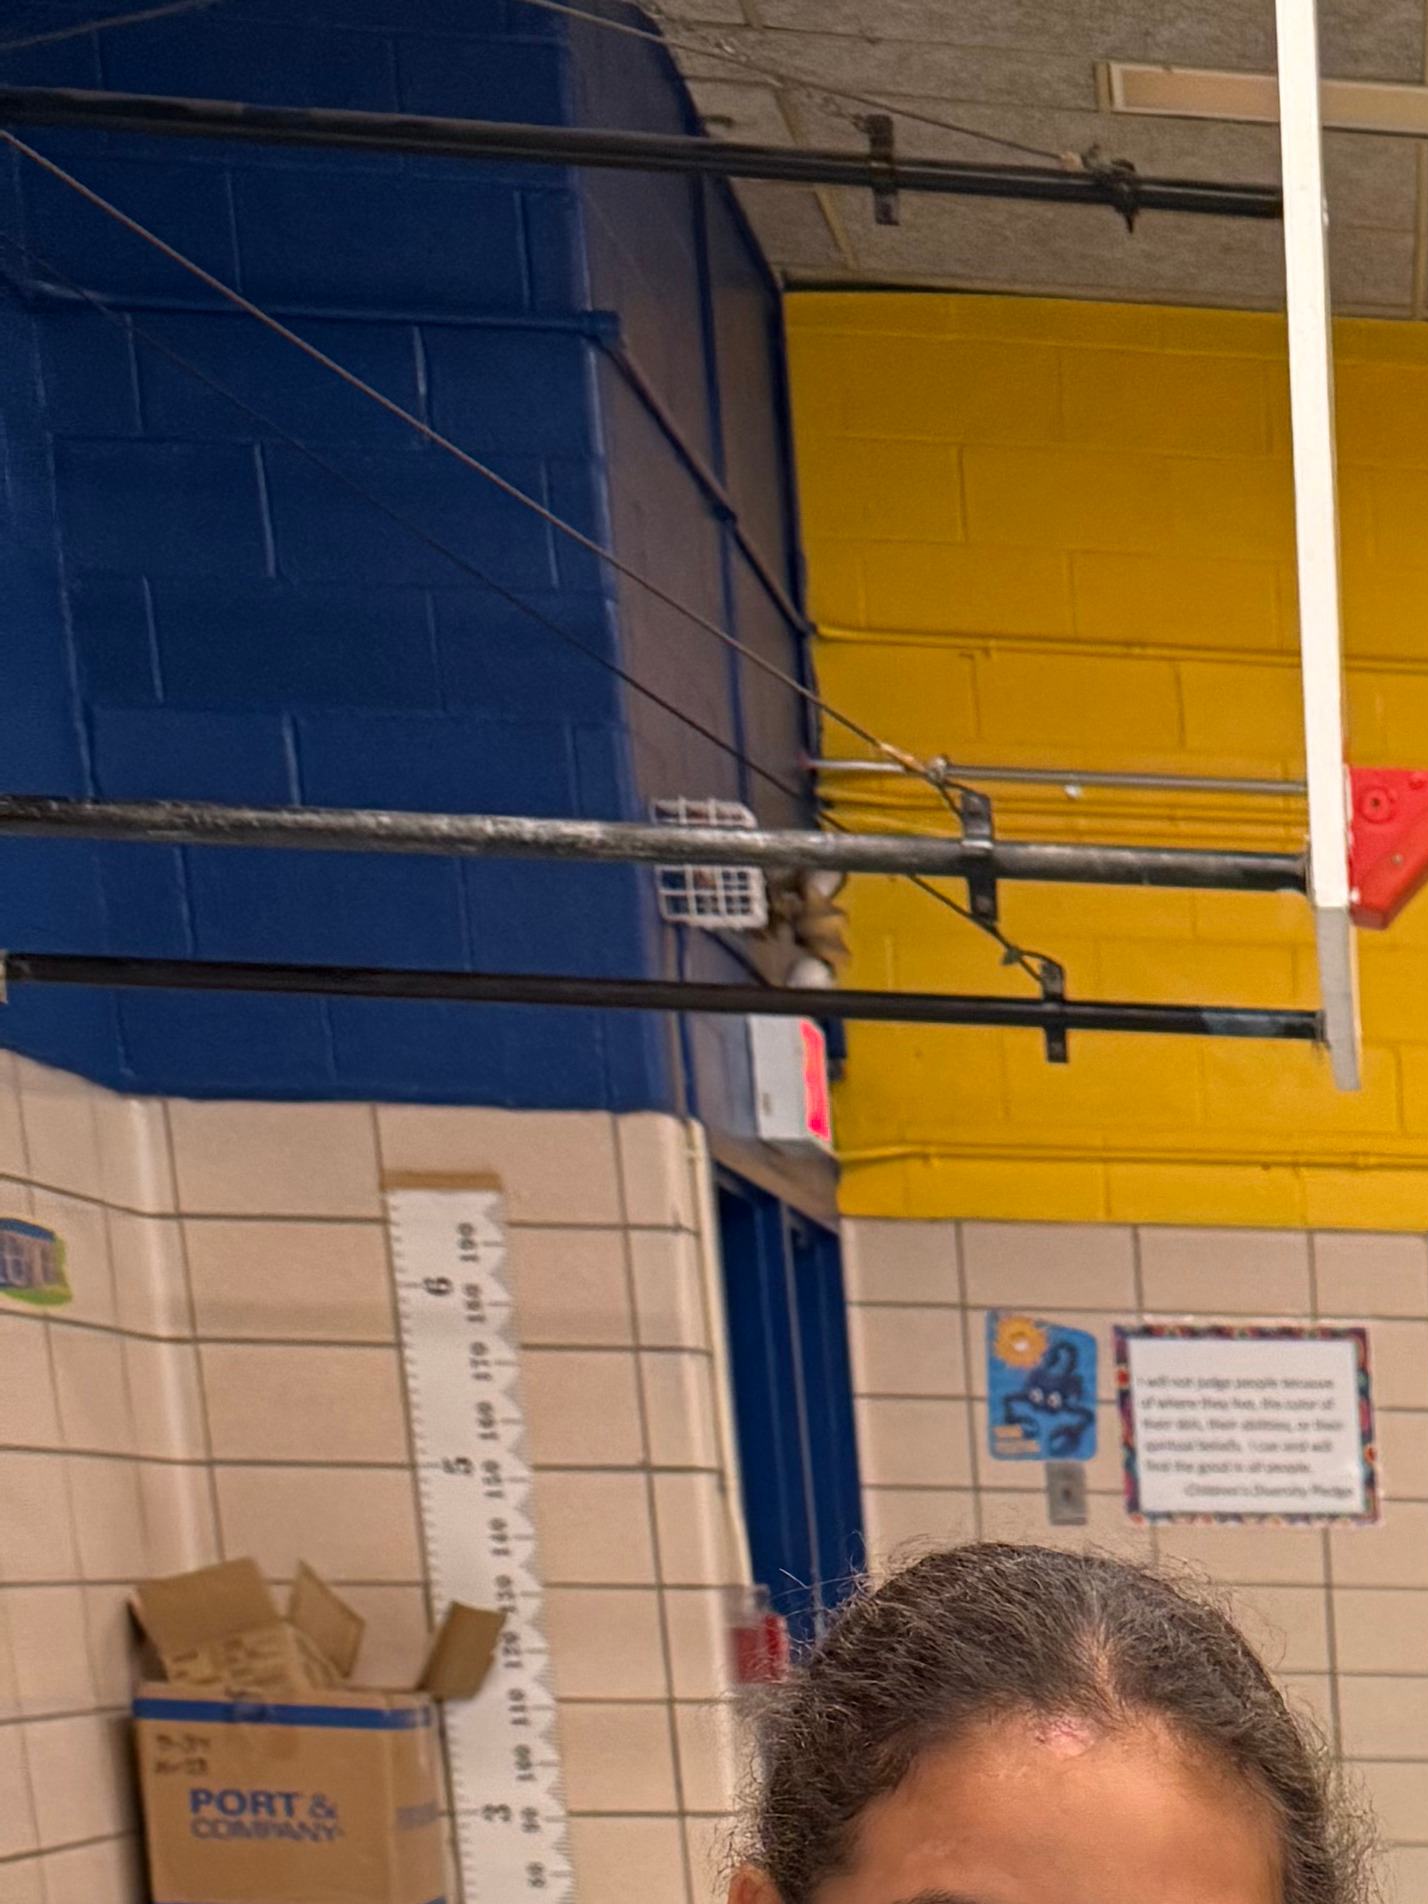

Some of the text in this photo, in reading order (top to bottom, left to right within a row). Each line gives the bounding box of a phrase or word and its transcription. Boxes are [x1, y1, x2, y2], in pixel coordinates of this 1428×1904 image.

[424, 1275, 452, 1297] 6
[442, 1456, 472, 1478] 5
[190, 1787, 337, 1820] PORT &
[482, 1803, 512, 1823] 3
[191, 1817, 339, 1843] COMPANY
